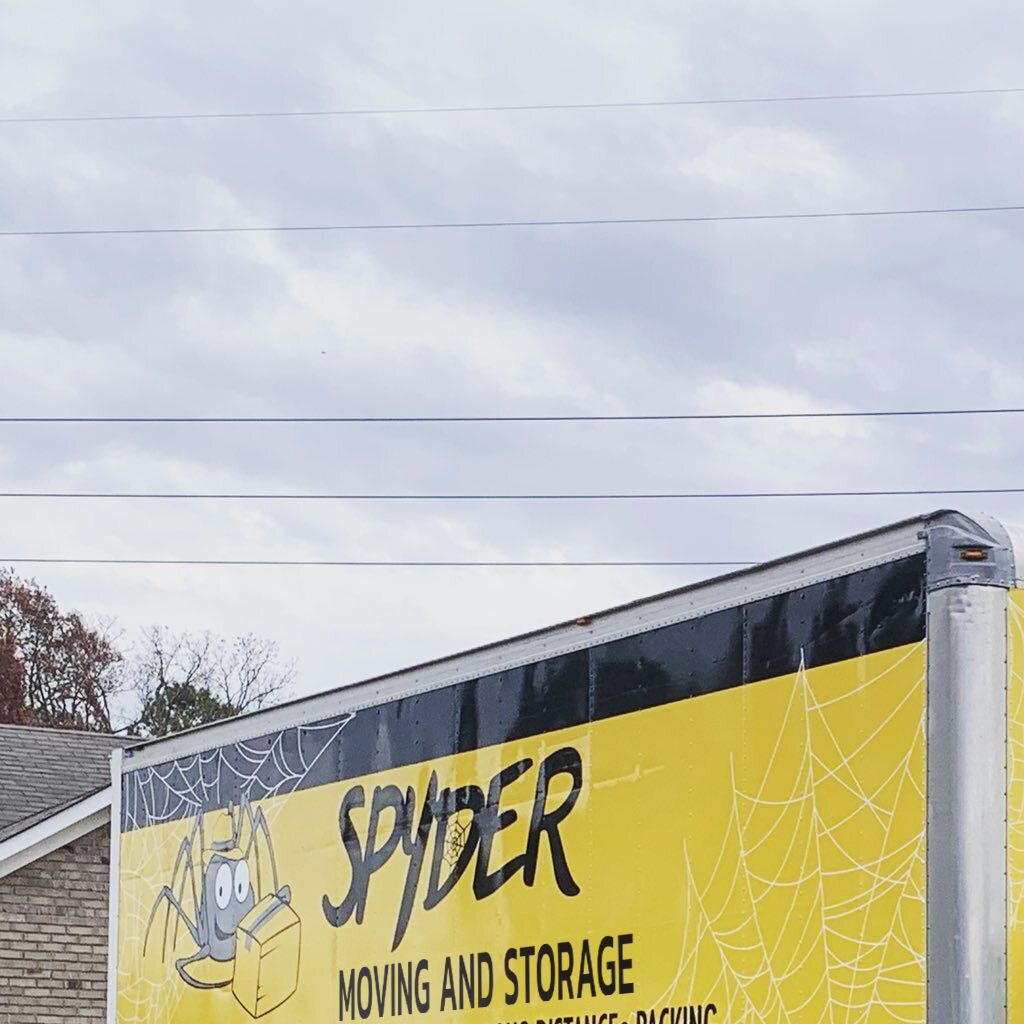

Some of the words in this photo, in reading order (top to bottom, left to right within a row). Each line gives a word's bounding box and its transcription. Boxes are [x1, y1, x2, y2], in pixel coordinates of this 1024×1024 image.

[321, 746, 584, 952] SPYDER
[339, 958, 430, 1022] MOVING
[439, 951, 494, 1012] AND
[504, 933, 635, 1005] STORAGE
